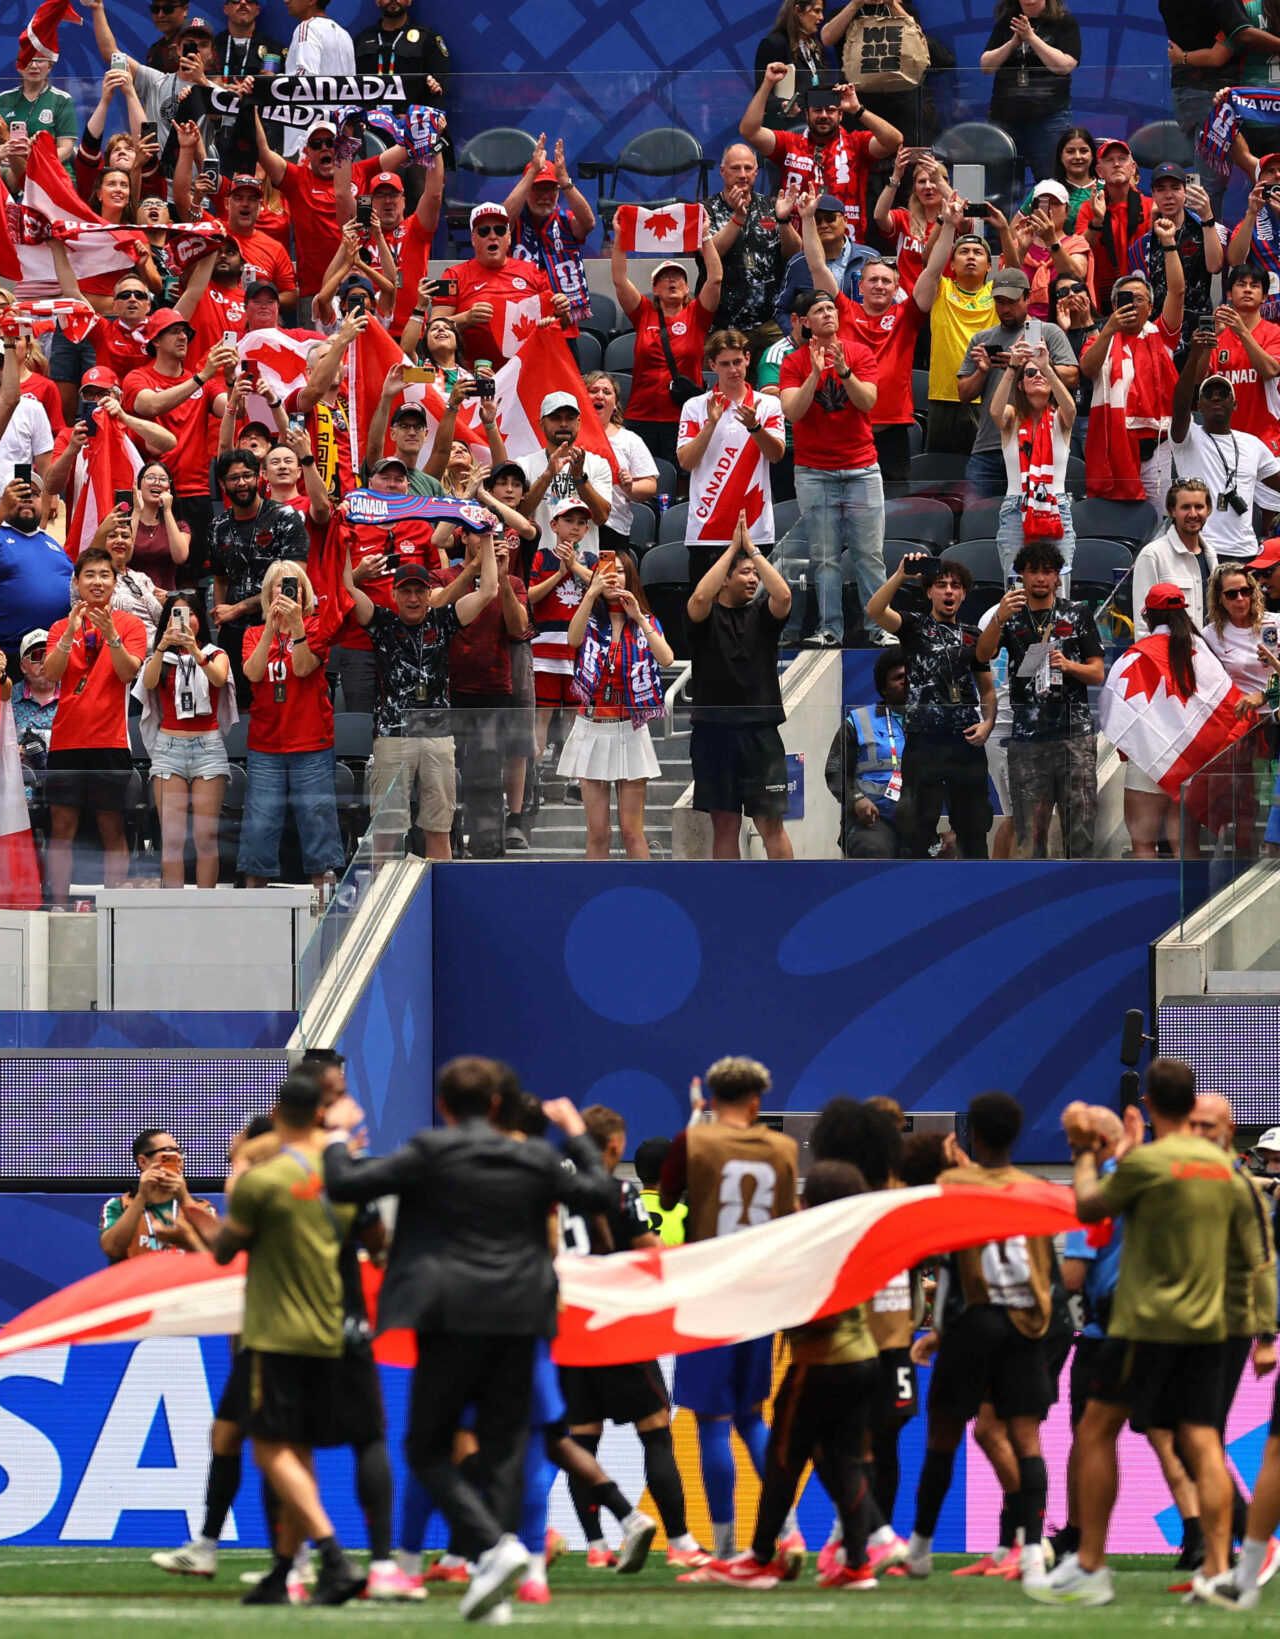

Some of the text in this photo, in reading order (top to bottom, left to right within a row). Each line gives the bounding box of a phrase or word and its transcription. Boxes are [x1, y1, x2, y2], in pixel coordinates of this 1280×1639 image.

[863, 26, 903, 43] WE
[861, 43, 902, 57] ARE
[271, 76, 406, 101] CANADA
[1232, 95, 1258, 110] FIFA
[696, 445, 739, 518] CANADA
[351, 497, 389, 515] CANADA
[268, 660, 287, 682] 19
[897, 1367, 912, 1399] 5
